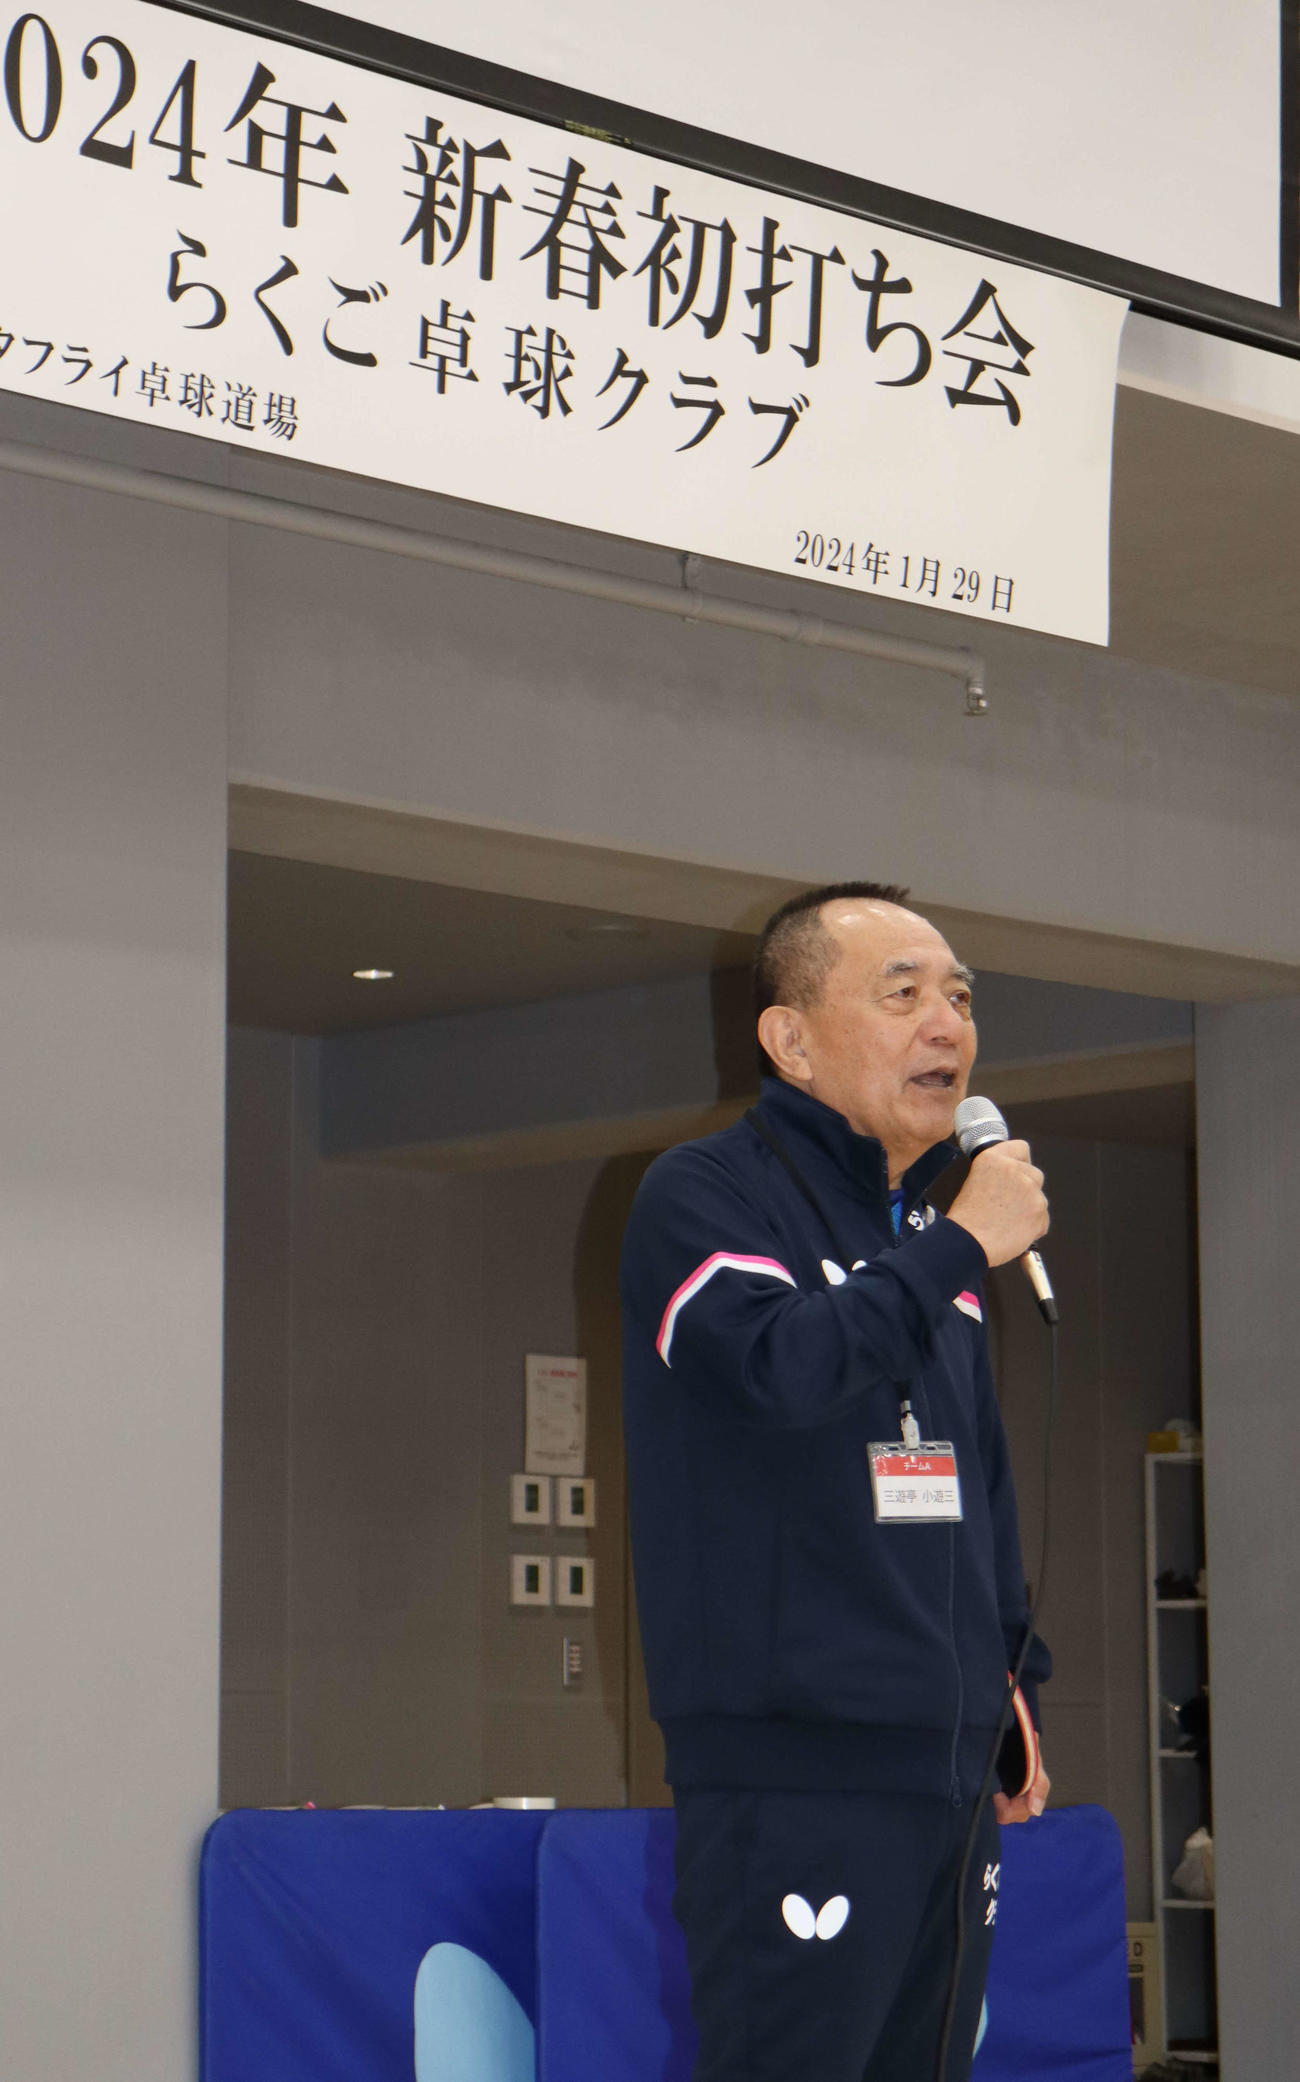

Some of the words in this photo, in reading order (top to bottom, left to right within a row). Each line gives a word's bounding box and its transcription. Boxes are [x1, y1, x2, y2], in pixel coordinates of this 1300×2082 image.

[167, 229, 811, 469] らくご卓球クラブ
[400, 115, 1036, 427] 新春初打ち会
